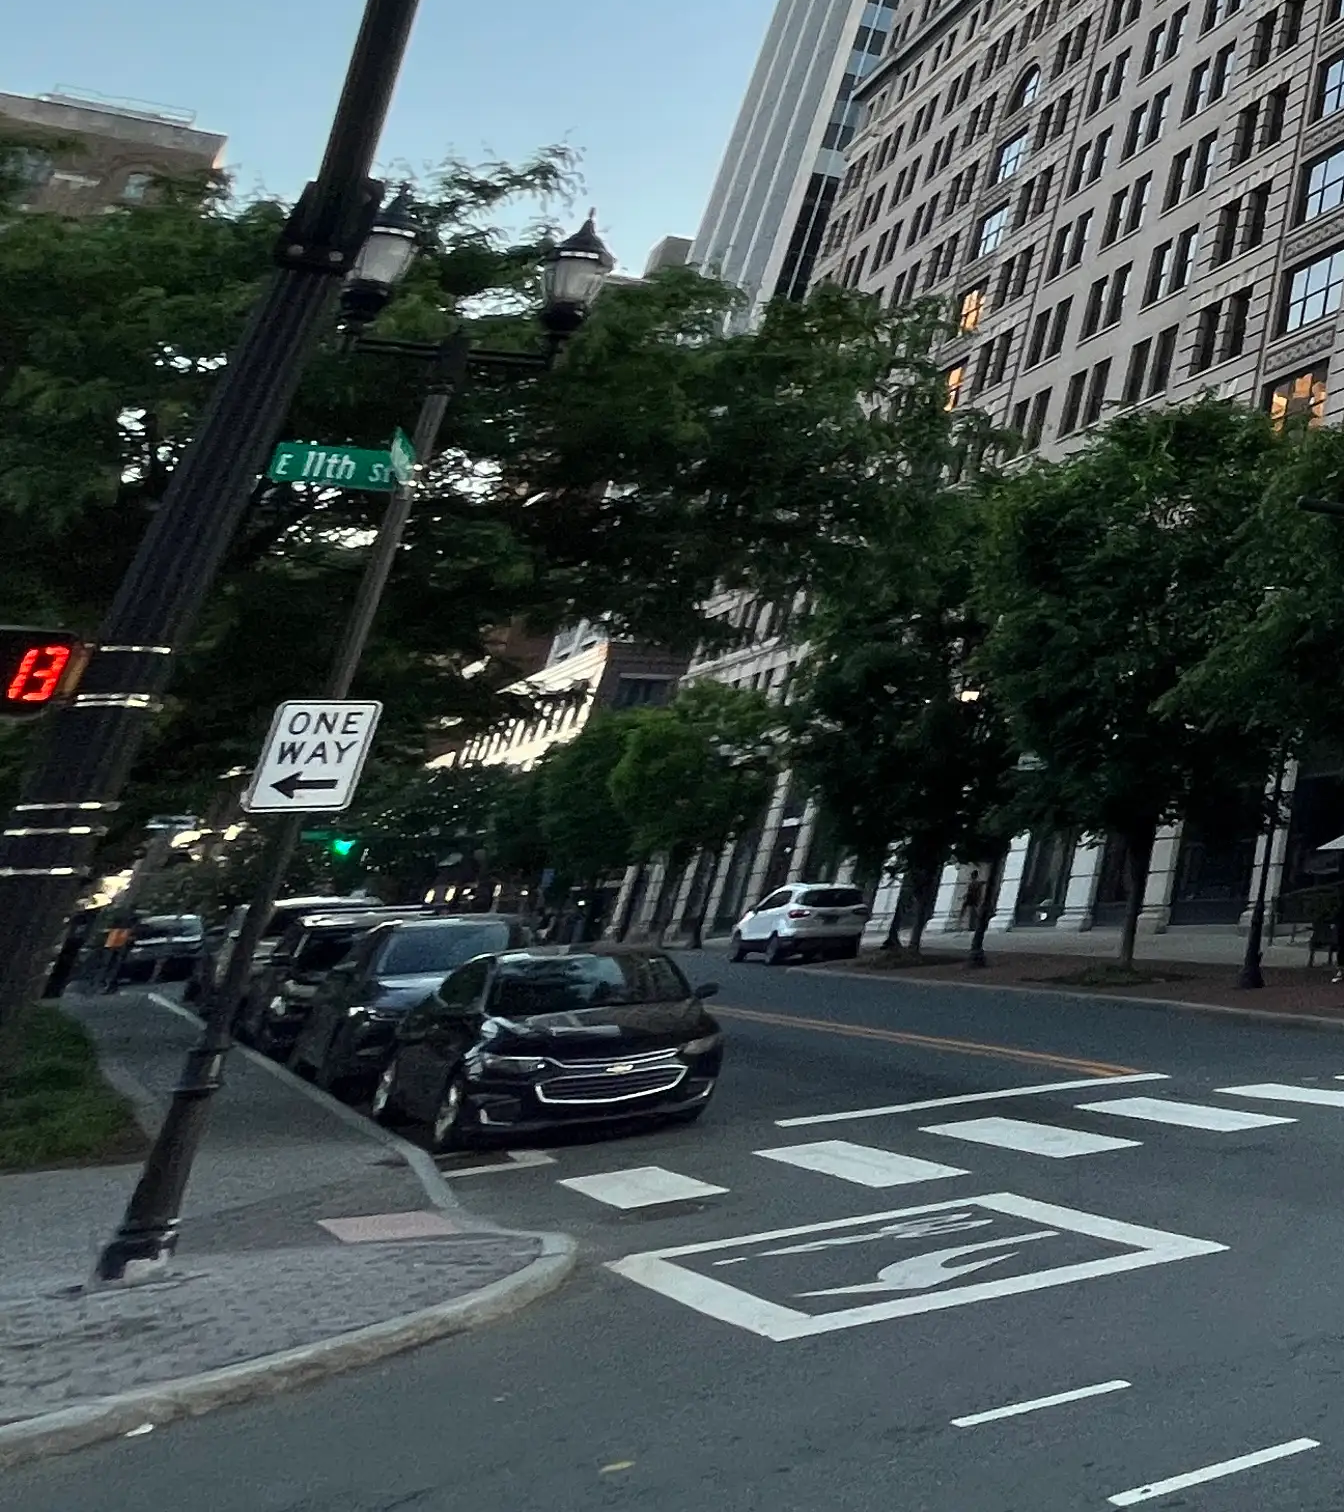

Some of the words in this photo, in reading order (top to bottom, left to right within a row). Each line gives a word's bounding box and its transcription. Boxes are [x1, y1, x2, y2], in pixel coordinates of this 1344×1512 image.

[275, 454, 293, 475] E
[301, 451, 356, 480] 11th
[288, 711, 364, 735] ONE
[277, 740, 359, 765] WAY
